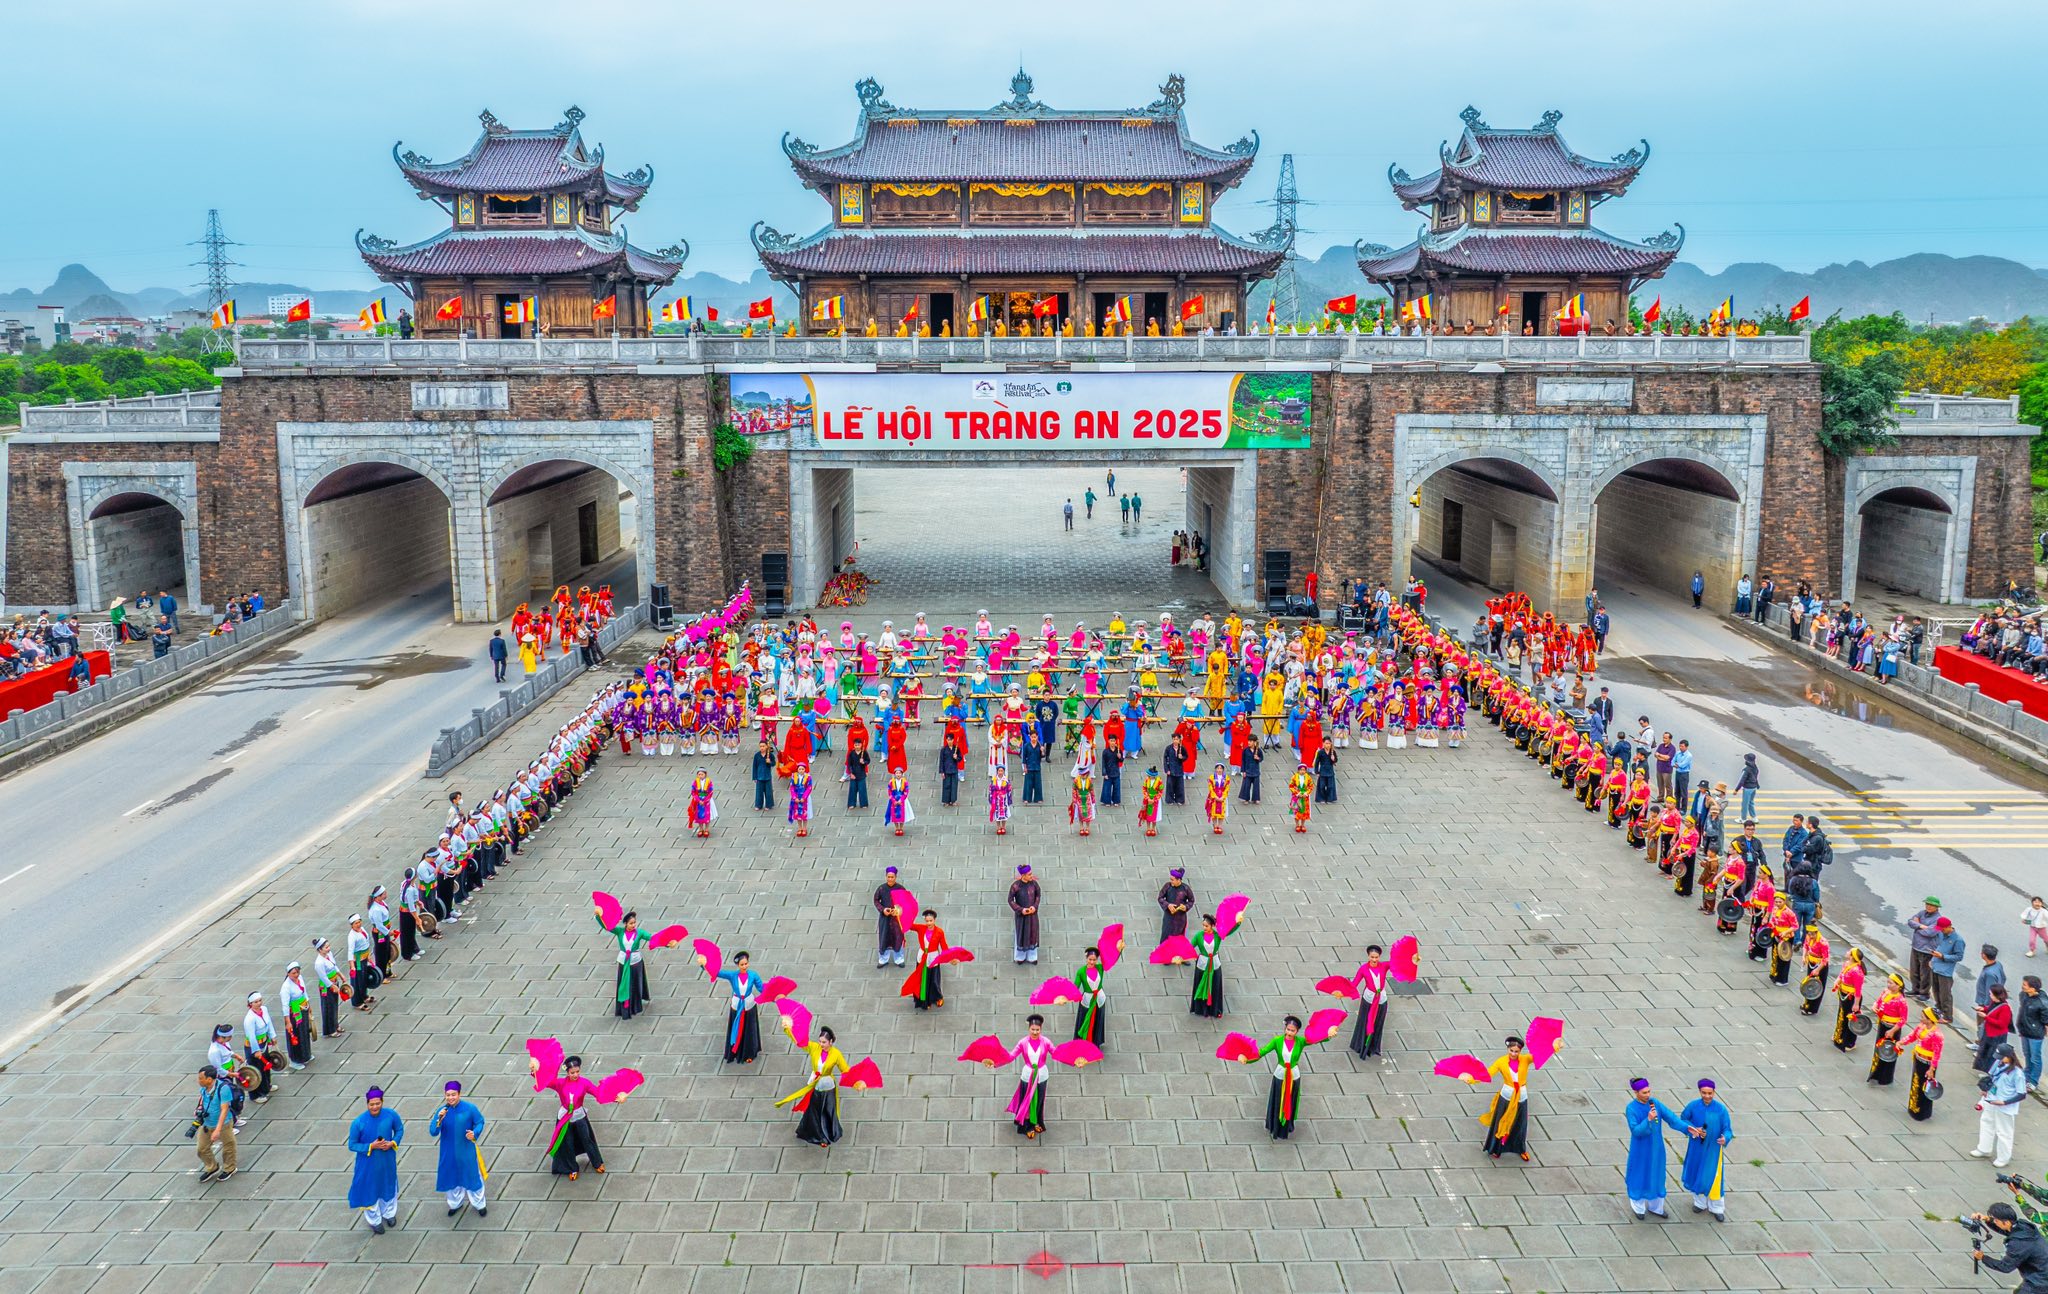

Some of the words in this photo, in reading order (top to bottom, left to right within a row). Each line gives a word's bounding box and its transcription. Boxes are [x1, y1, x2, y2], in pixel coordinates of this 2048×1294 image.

[824, 406, 873, 440] LỄ
[877, 406, 932, 446] HỘI
[944, 400, 1061, 440] TRÀNG
[1074, 411, 1119, 440] AN
[1133, 409, 1222, 439] 2025
